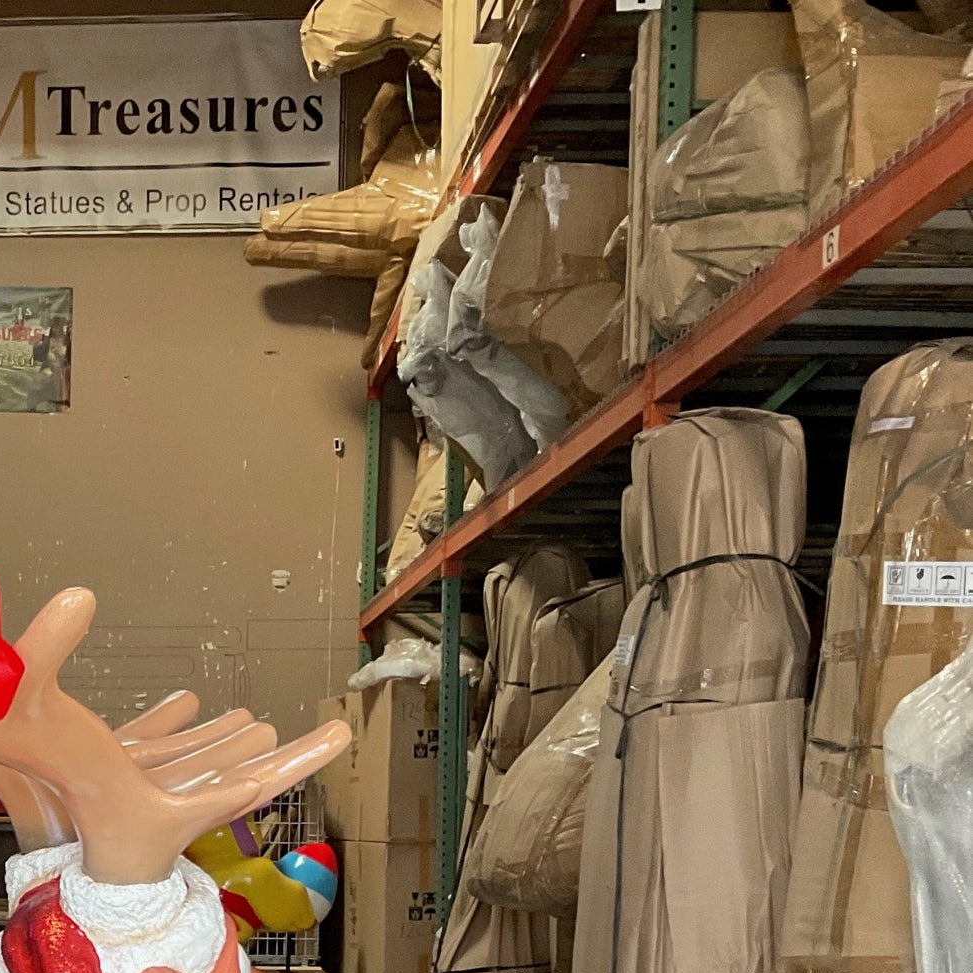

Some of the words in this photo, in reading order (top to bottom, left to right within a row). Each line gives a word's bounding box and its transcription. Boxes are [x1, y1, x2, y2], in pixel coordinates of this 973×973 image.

[47, 86, 324, 136] Treasures
[5, 190, 106, 215] Statues
[117, 190, 134, 213] &
[146, 189, 207, 217] Prop
[219, 187, 325, 212] Rental
[827, 232, 834, 263] 6
